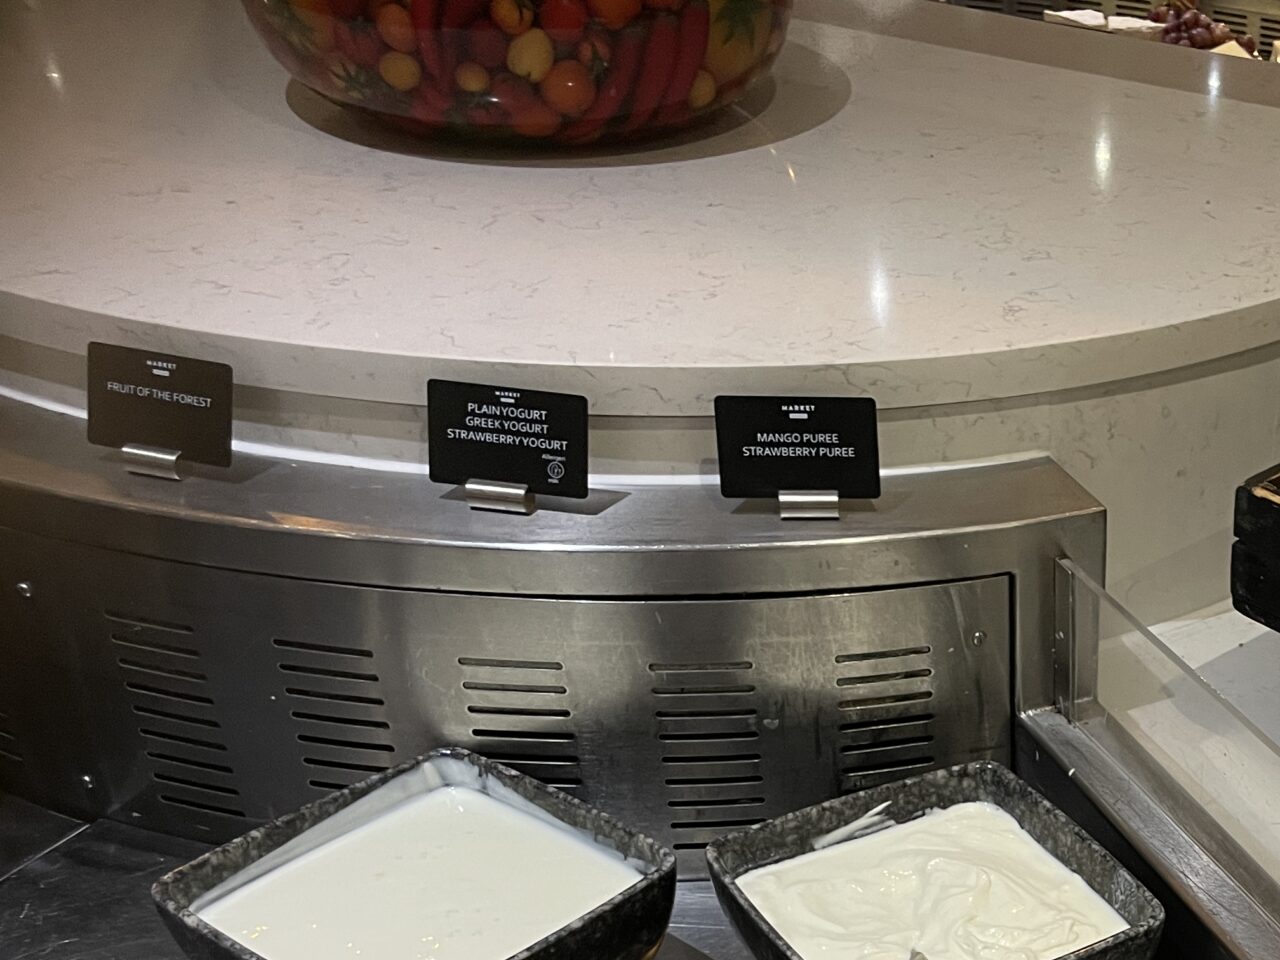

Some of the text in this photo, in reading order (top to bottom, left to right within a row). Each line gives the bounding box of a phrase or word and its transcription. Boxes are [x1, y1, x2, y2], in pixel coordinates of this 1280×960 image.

[107, 381, 212, 408] FRUIT OF THE FOREST
[467, 403, 548, 421] PLAIN YOGURT
[466, 416, 549, 435] GREEK YOGURT
[447, 429, 568, 451] STRAWBERRY YOGURT
[757, 433, 839, 444] MANGO PUREE
[742, 446, 855, 458] STRAWBERRY PUREE
